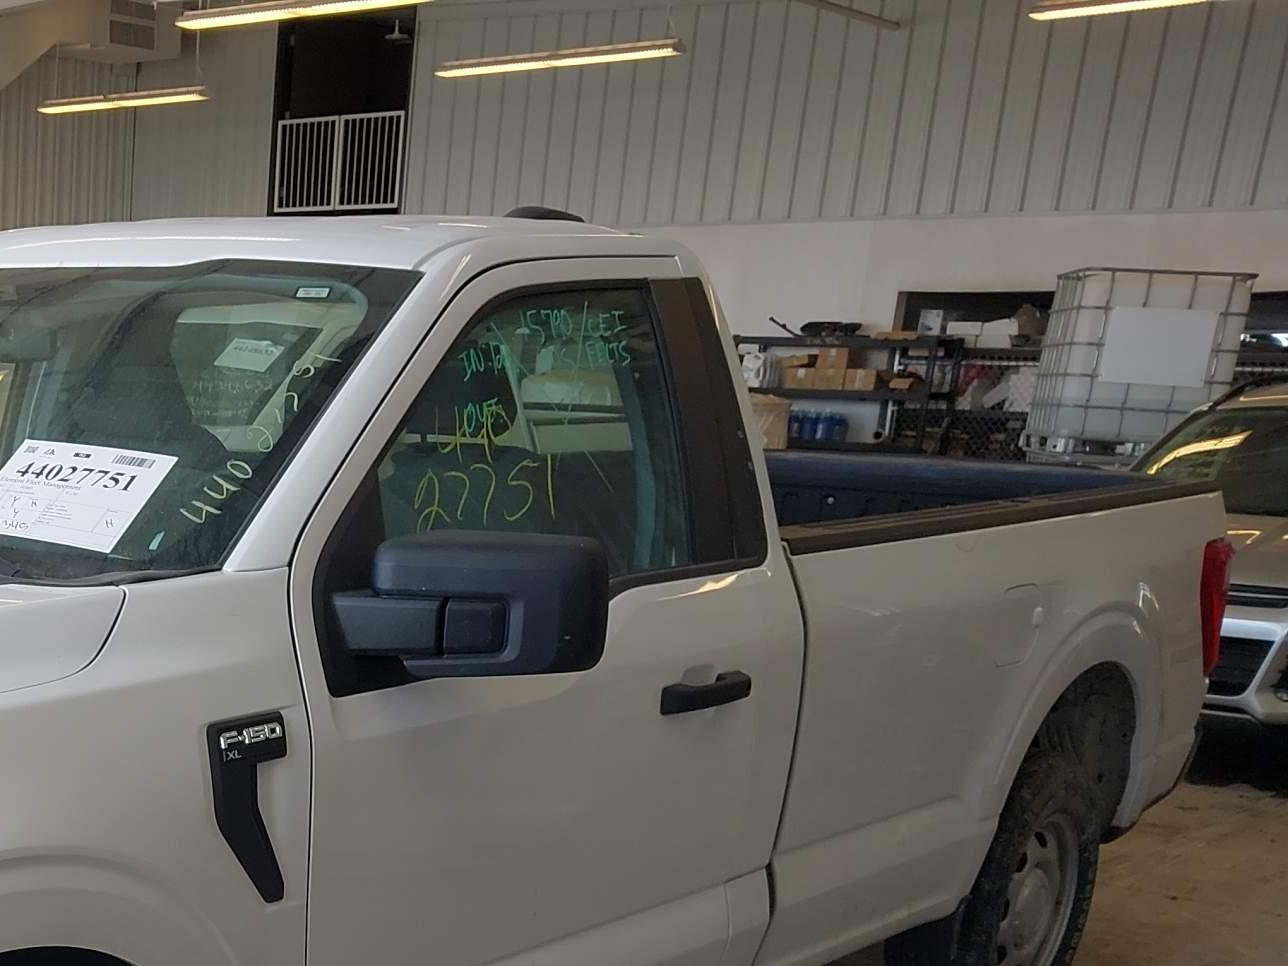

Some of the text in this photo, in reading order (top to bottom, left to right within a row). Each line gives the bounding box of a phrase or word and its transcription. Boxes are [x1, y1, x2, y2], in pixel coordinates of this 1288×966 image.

[16, 462, 138, 493] 44027751
[414, 453, 556, 534] 27751
[219, 721, 283, 750] F-150
[226, 749, 243, 761] XL
